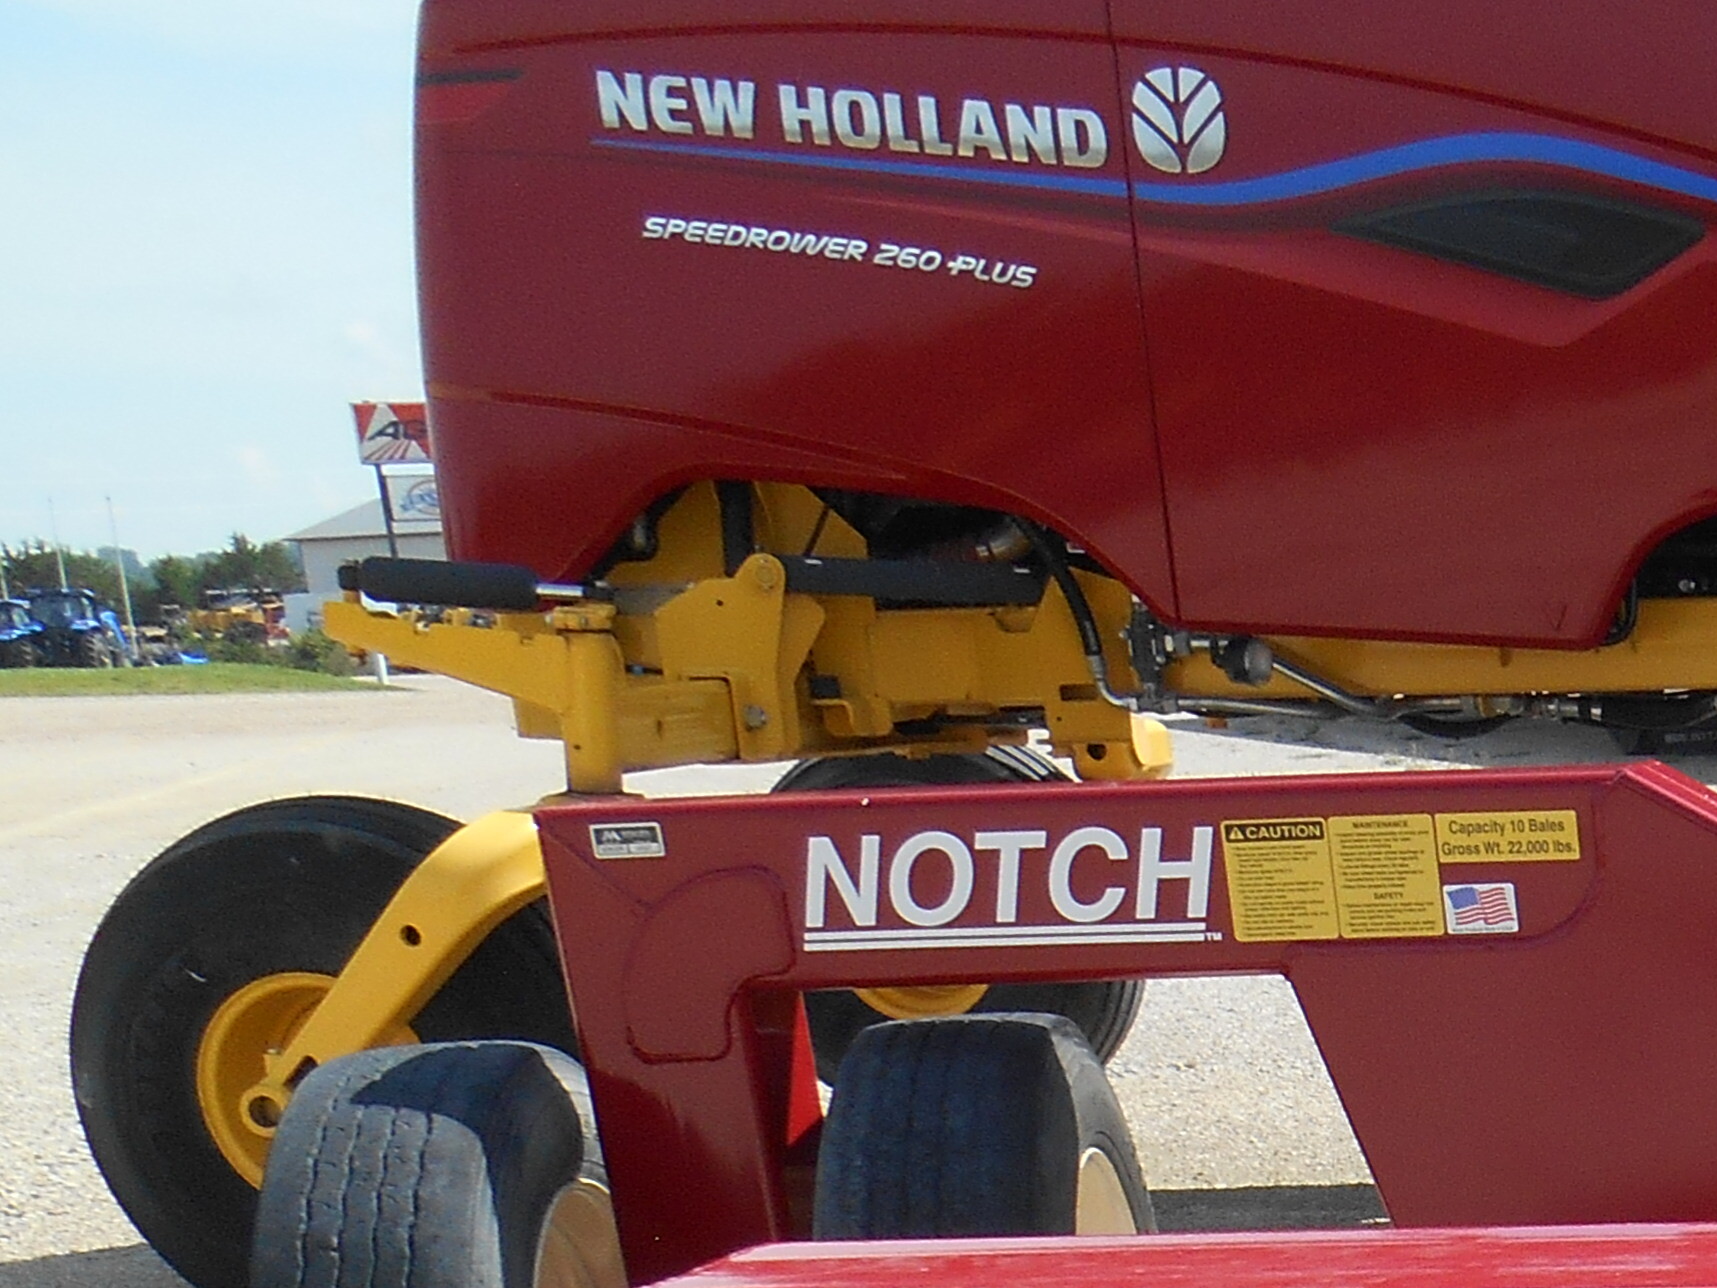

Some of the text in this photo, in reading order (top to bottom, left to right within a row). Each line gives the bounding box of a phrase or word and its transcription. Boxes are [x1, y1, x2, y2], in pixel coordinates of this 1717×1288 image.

[595, 69, 1108, 169] NEW HOLLAND
[642, 216, 867, 263] SPEEDROWER
[873, 243, 942, 273] 260
[1246, 824, 1321, 839] CAUTION
[1449, 818, 1565, 836] Capacity 10 Bales
[1442, 839, 1577, 857] Gross Wt. 22,000 lbs.
[805, 826, 1213, 928] NOTCH
[1205, 932, 1223, 941] TM
